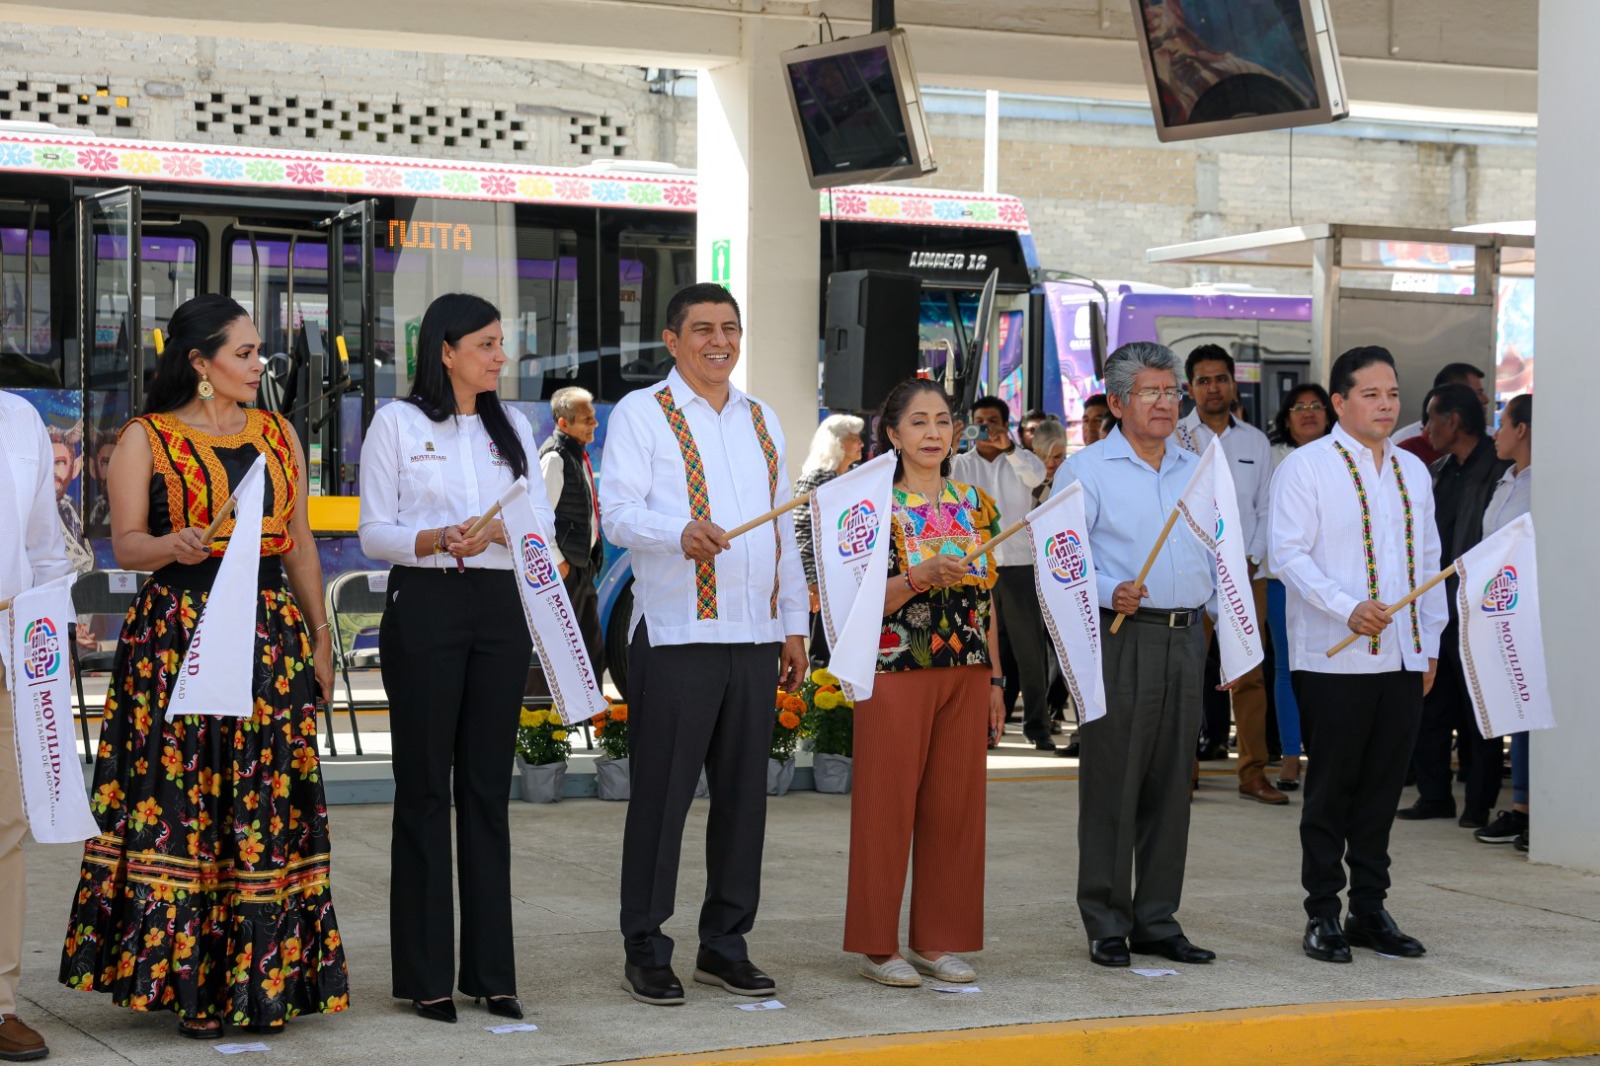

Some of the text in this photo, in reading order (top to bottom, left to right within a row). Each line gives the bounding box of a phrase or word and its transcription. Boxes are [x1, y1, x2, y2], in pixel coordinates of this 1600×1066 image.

[966, 254, 987, 270] 12
[551, 593, 595, 691] MOVILIDAD
[1229, 615, 1253, 657] MOVILIDAD
[1501, 621, 1531, 702] MOVILIDAD
[576, 662, 595, 713] MOVILIDAD
[1509, 679, 1525, 720] MOVILIDAD
[41, 755, 49, 767] DE
